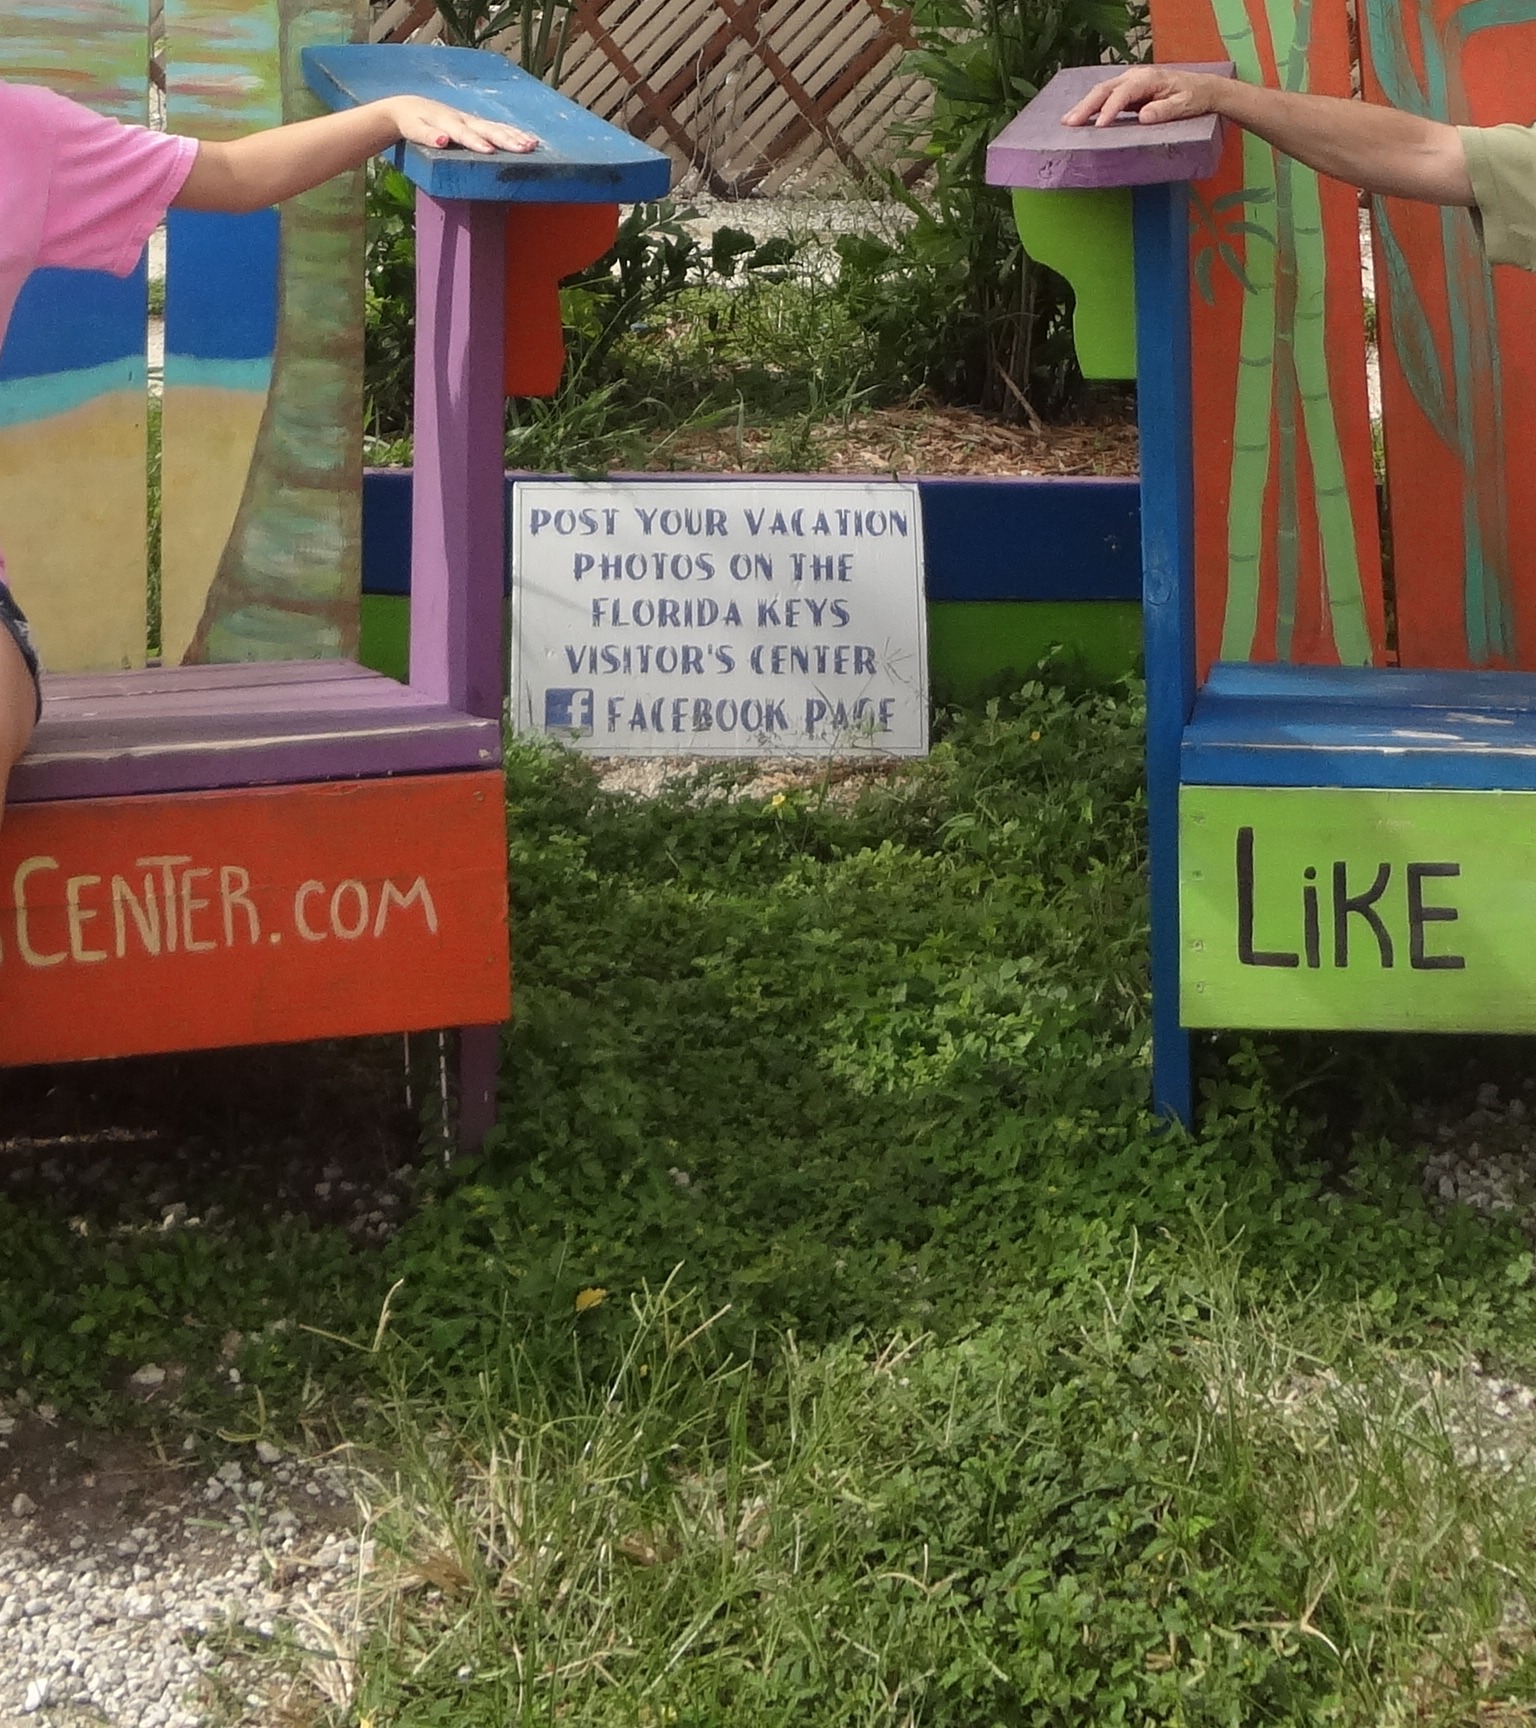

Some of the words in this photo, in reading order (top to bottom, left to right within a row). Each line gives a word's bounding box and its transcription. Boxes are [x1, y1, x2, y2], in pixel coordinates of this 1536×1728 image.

[530, 507, 619, 536] POST
[635, 507, 729, 536] YOUR
[744, 507, 909, 537] VACATION
[572, 552, 716, 582] PHOTOS
[729, 553, 773, 581] ON
[789, 552, 855, 582] THE
[591, 597, 743, 627] FLORIDA
[757, 597, 852, 628] KEYS
[564, 643, 736, 675] VISITOR'S
[749, 643, 878, 675] CENTER
[607, 697, 789, 734] FACEBOOK
[805, 697, 896, 735] PAGE
